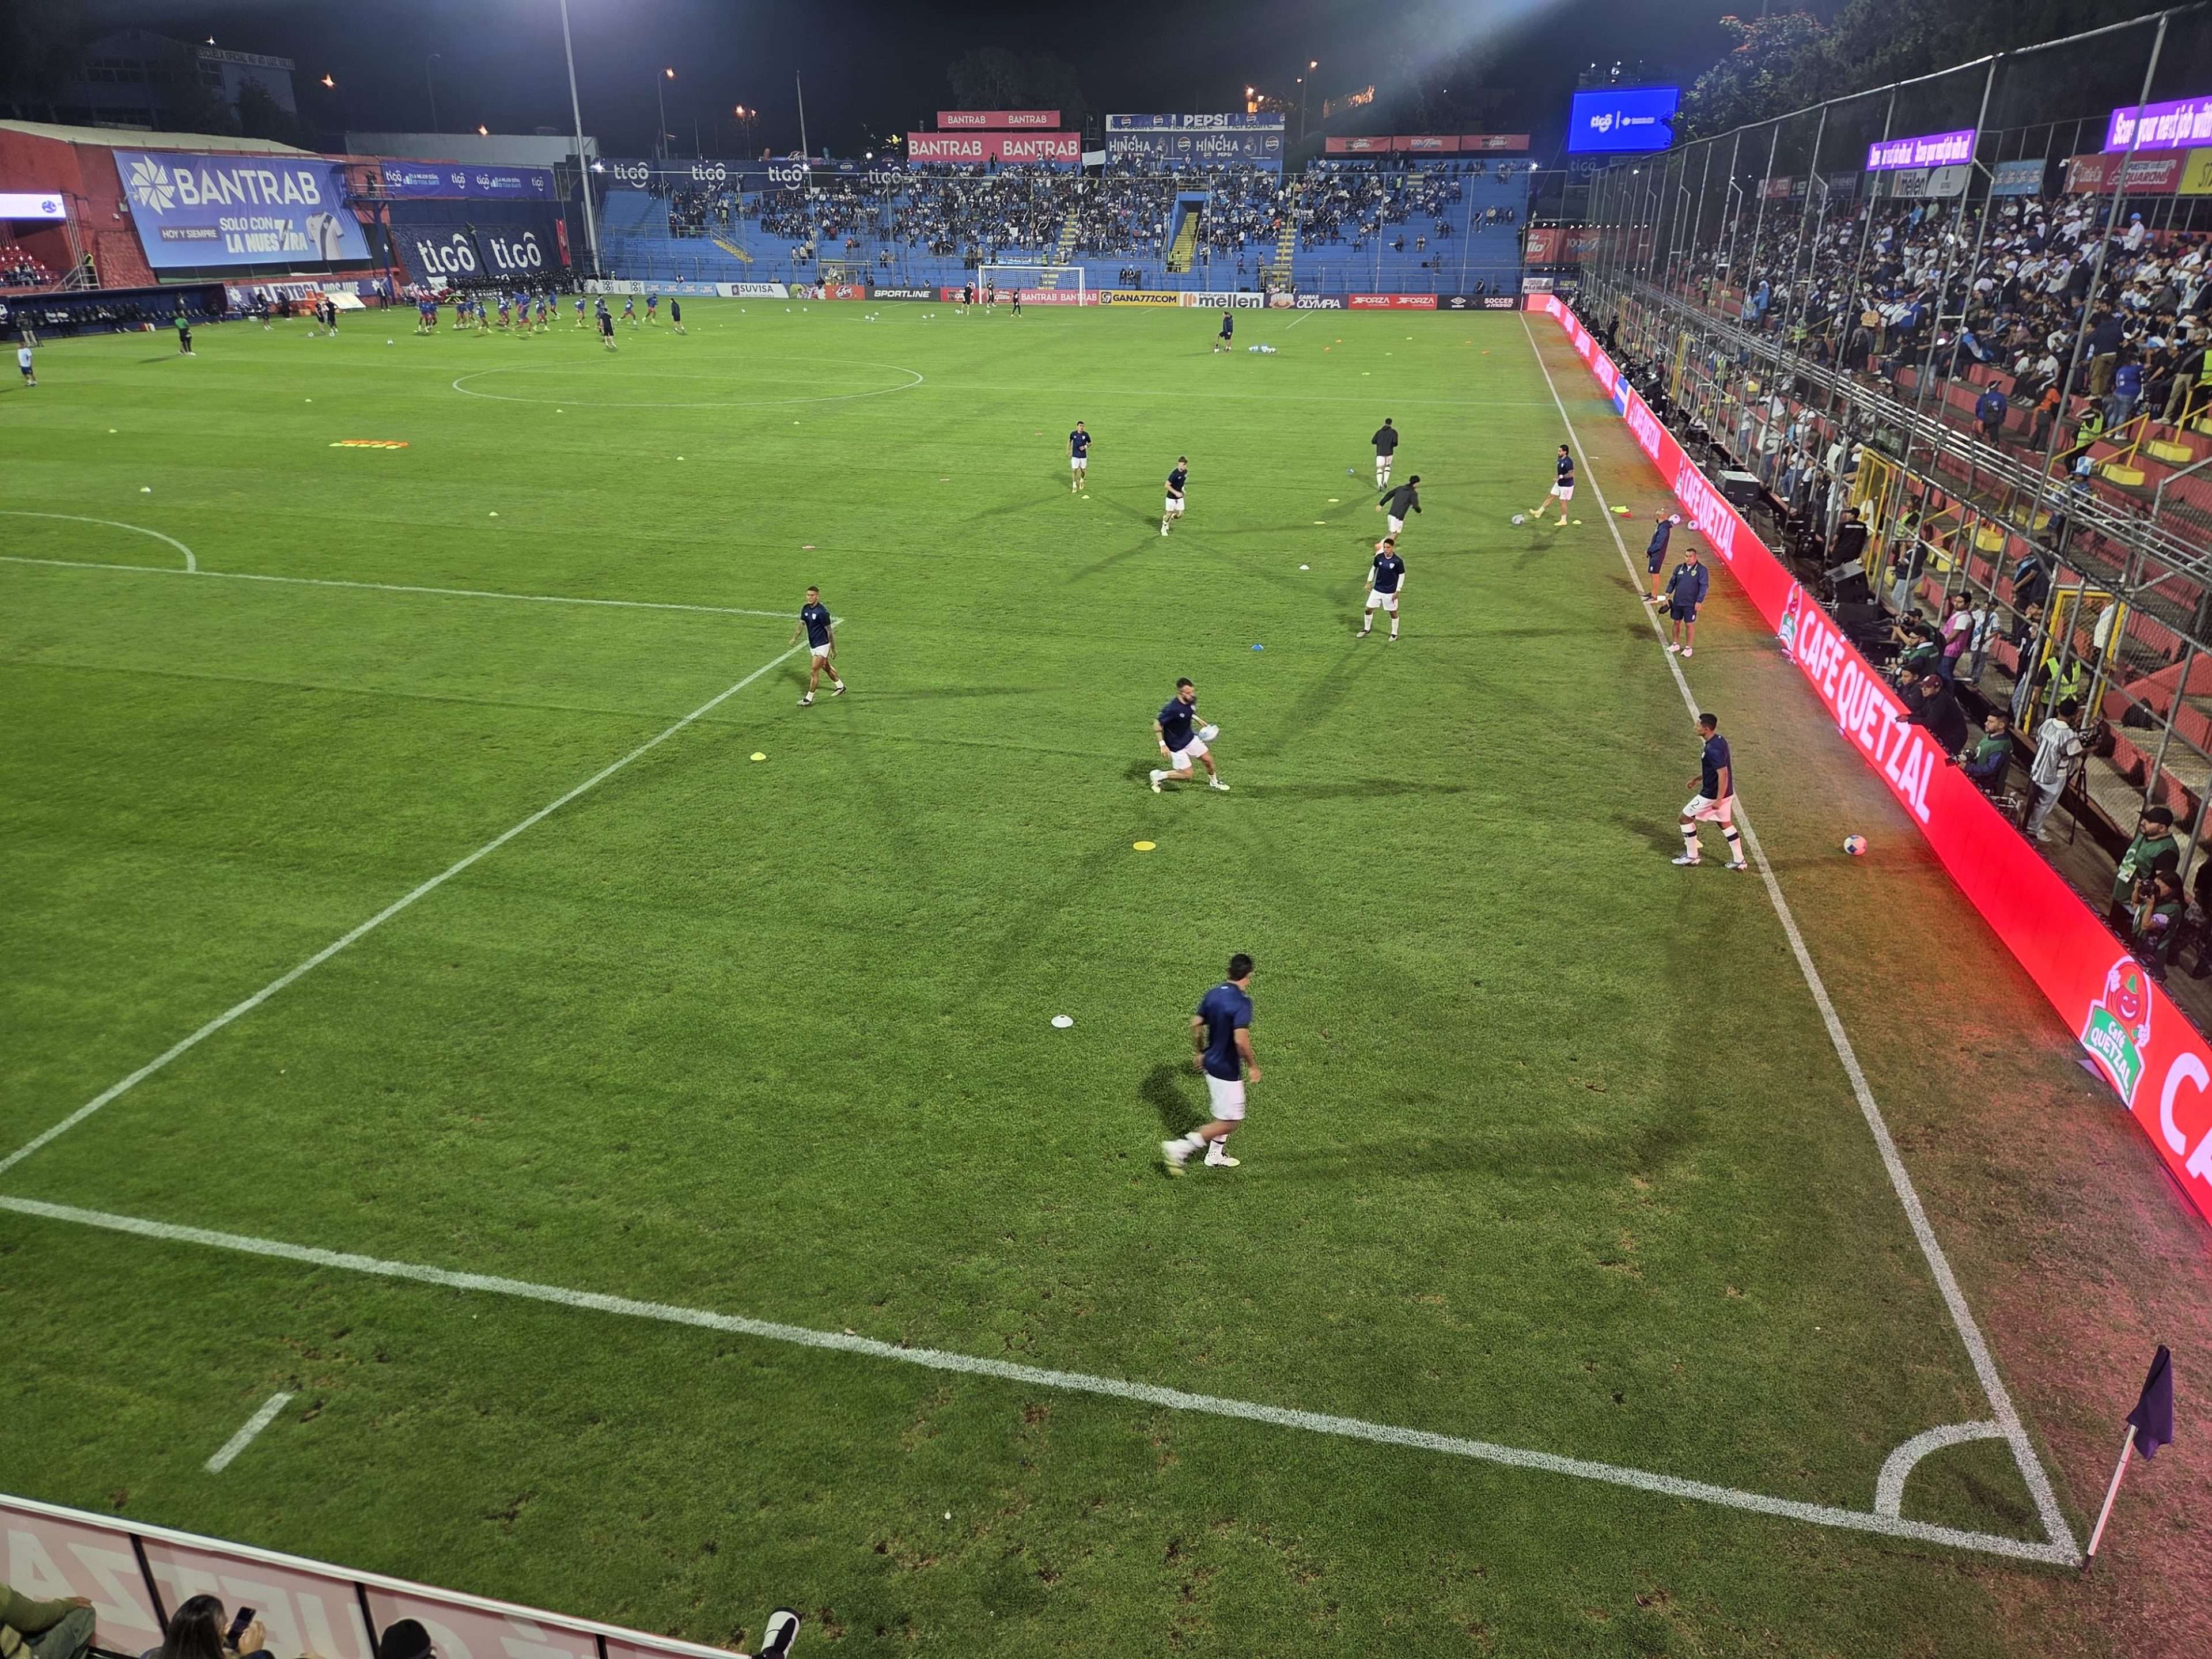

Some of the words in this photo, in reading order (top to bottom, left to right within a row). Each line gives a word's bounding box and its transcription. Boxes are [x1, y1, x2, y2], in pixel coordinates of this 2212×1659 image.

[948, 116, 986, 124] BANTRAB
[1009, 115, 1047, 123] BANTRAB
[1184, 114, 1228, 126] PEPSI
[908, 141, 982, 156] BANTRAB
[1003, 141, 1078, 156] BANTRAB
[1109, 135, 1150, 152] HINCHA
[1196, 134, 1238, 151] HINCHA
[173, 168, 321, 204] BANTRAB
[219, 217, 245, 230] SOLO
[249, 217, 275, 230] CON
[187, 230, 217, 238] SIEMPRE
[226, 233, 245, 253] LA
[740, 285, 774, 293] SUVISA
[1113, 294, 1177, 303] GANA777.COM
[1199, 294, 1260, 308] mellen
[1297, 299, 1341, 309] OLYMPIA
[1699, 487, 1736, 561] QUETZAL
[1798, 610, 1847, 700] CAFÉ
[1836, 660, 1935, 824] QUETZAL
[1691, 798, 1700, 809] 2
[2108, 1021, 2125, 1049] Café
[2090, 1027, 2131, 1090] QUETZAL
